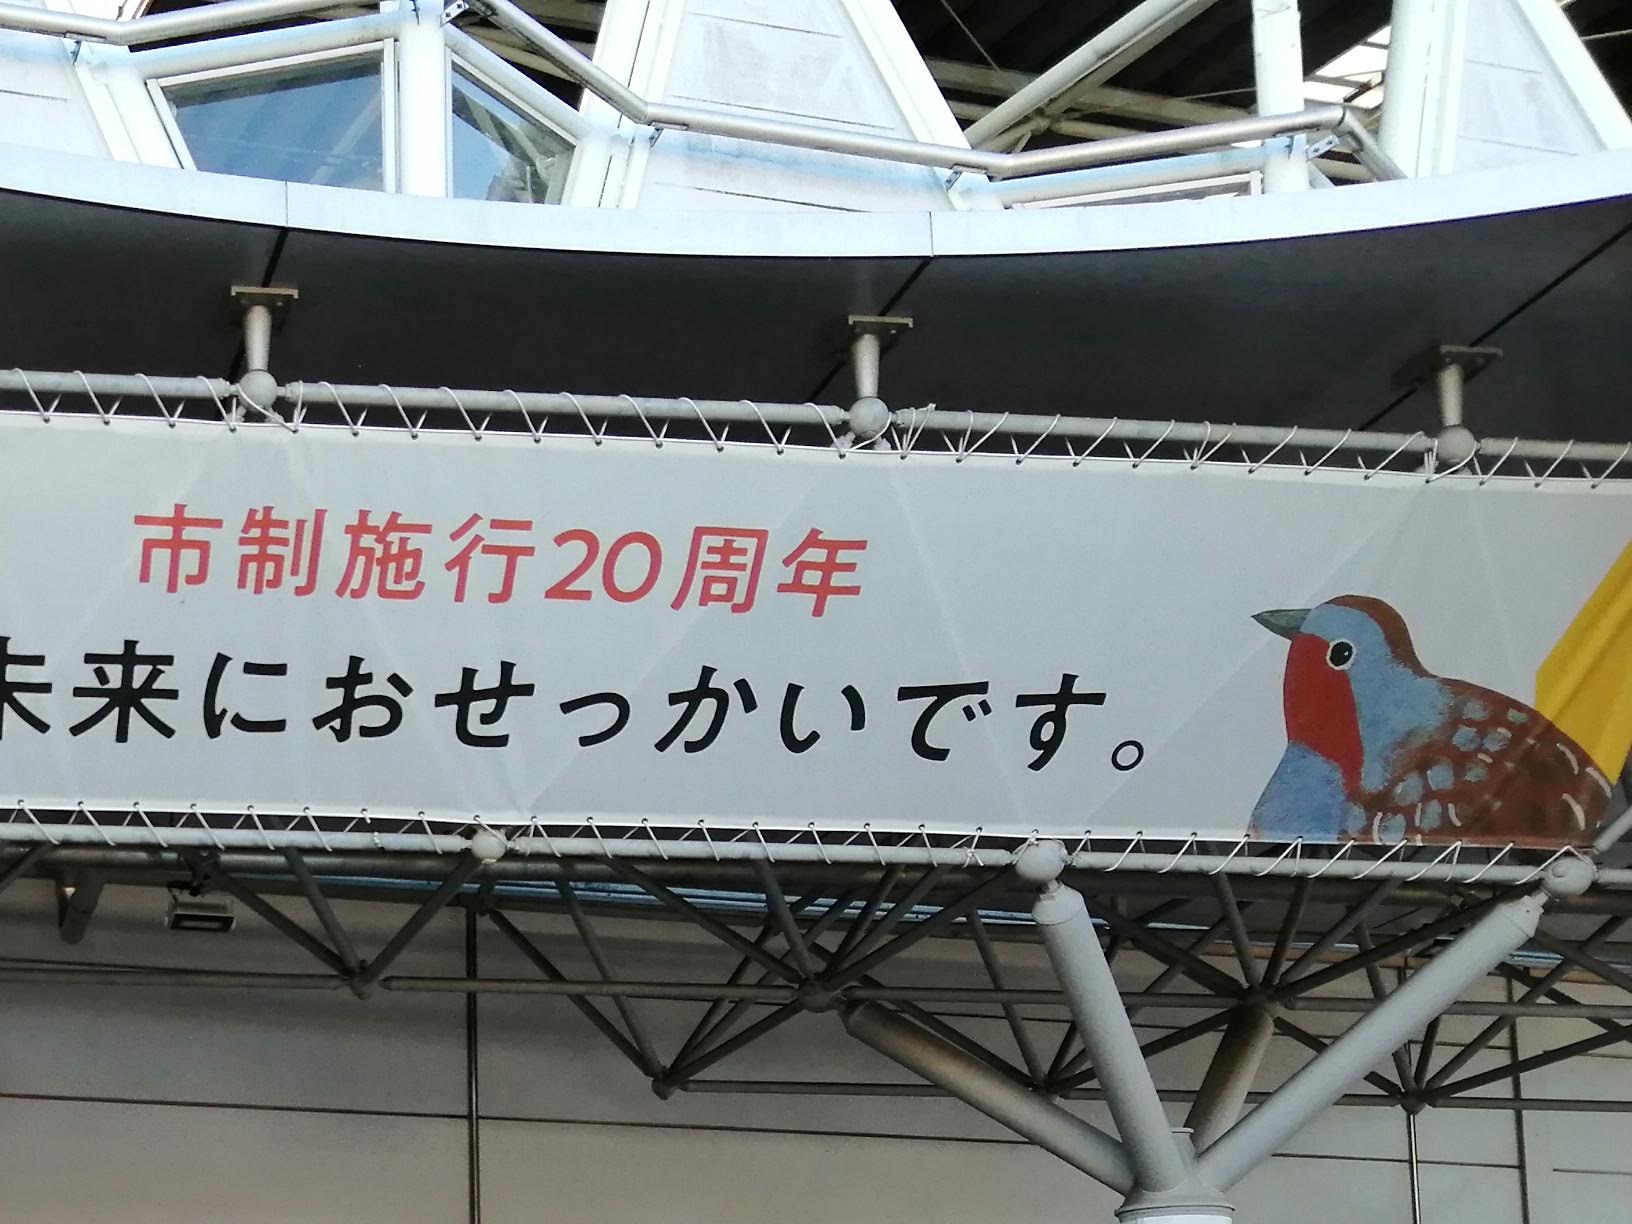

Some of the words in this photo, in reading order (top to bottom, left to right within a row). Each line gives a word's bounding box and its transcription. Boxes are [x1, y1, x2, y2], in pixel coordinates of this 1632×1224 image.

[133, 502, 870, 618] 市制施行20周年
